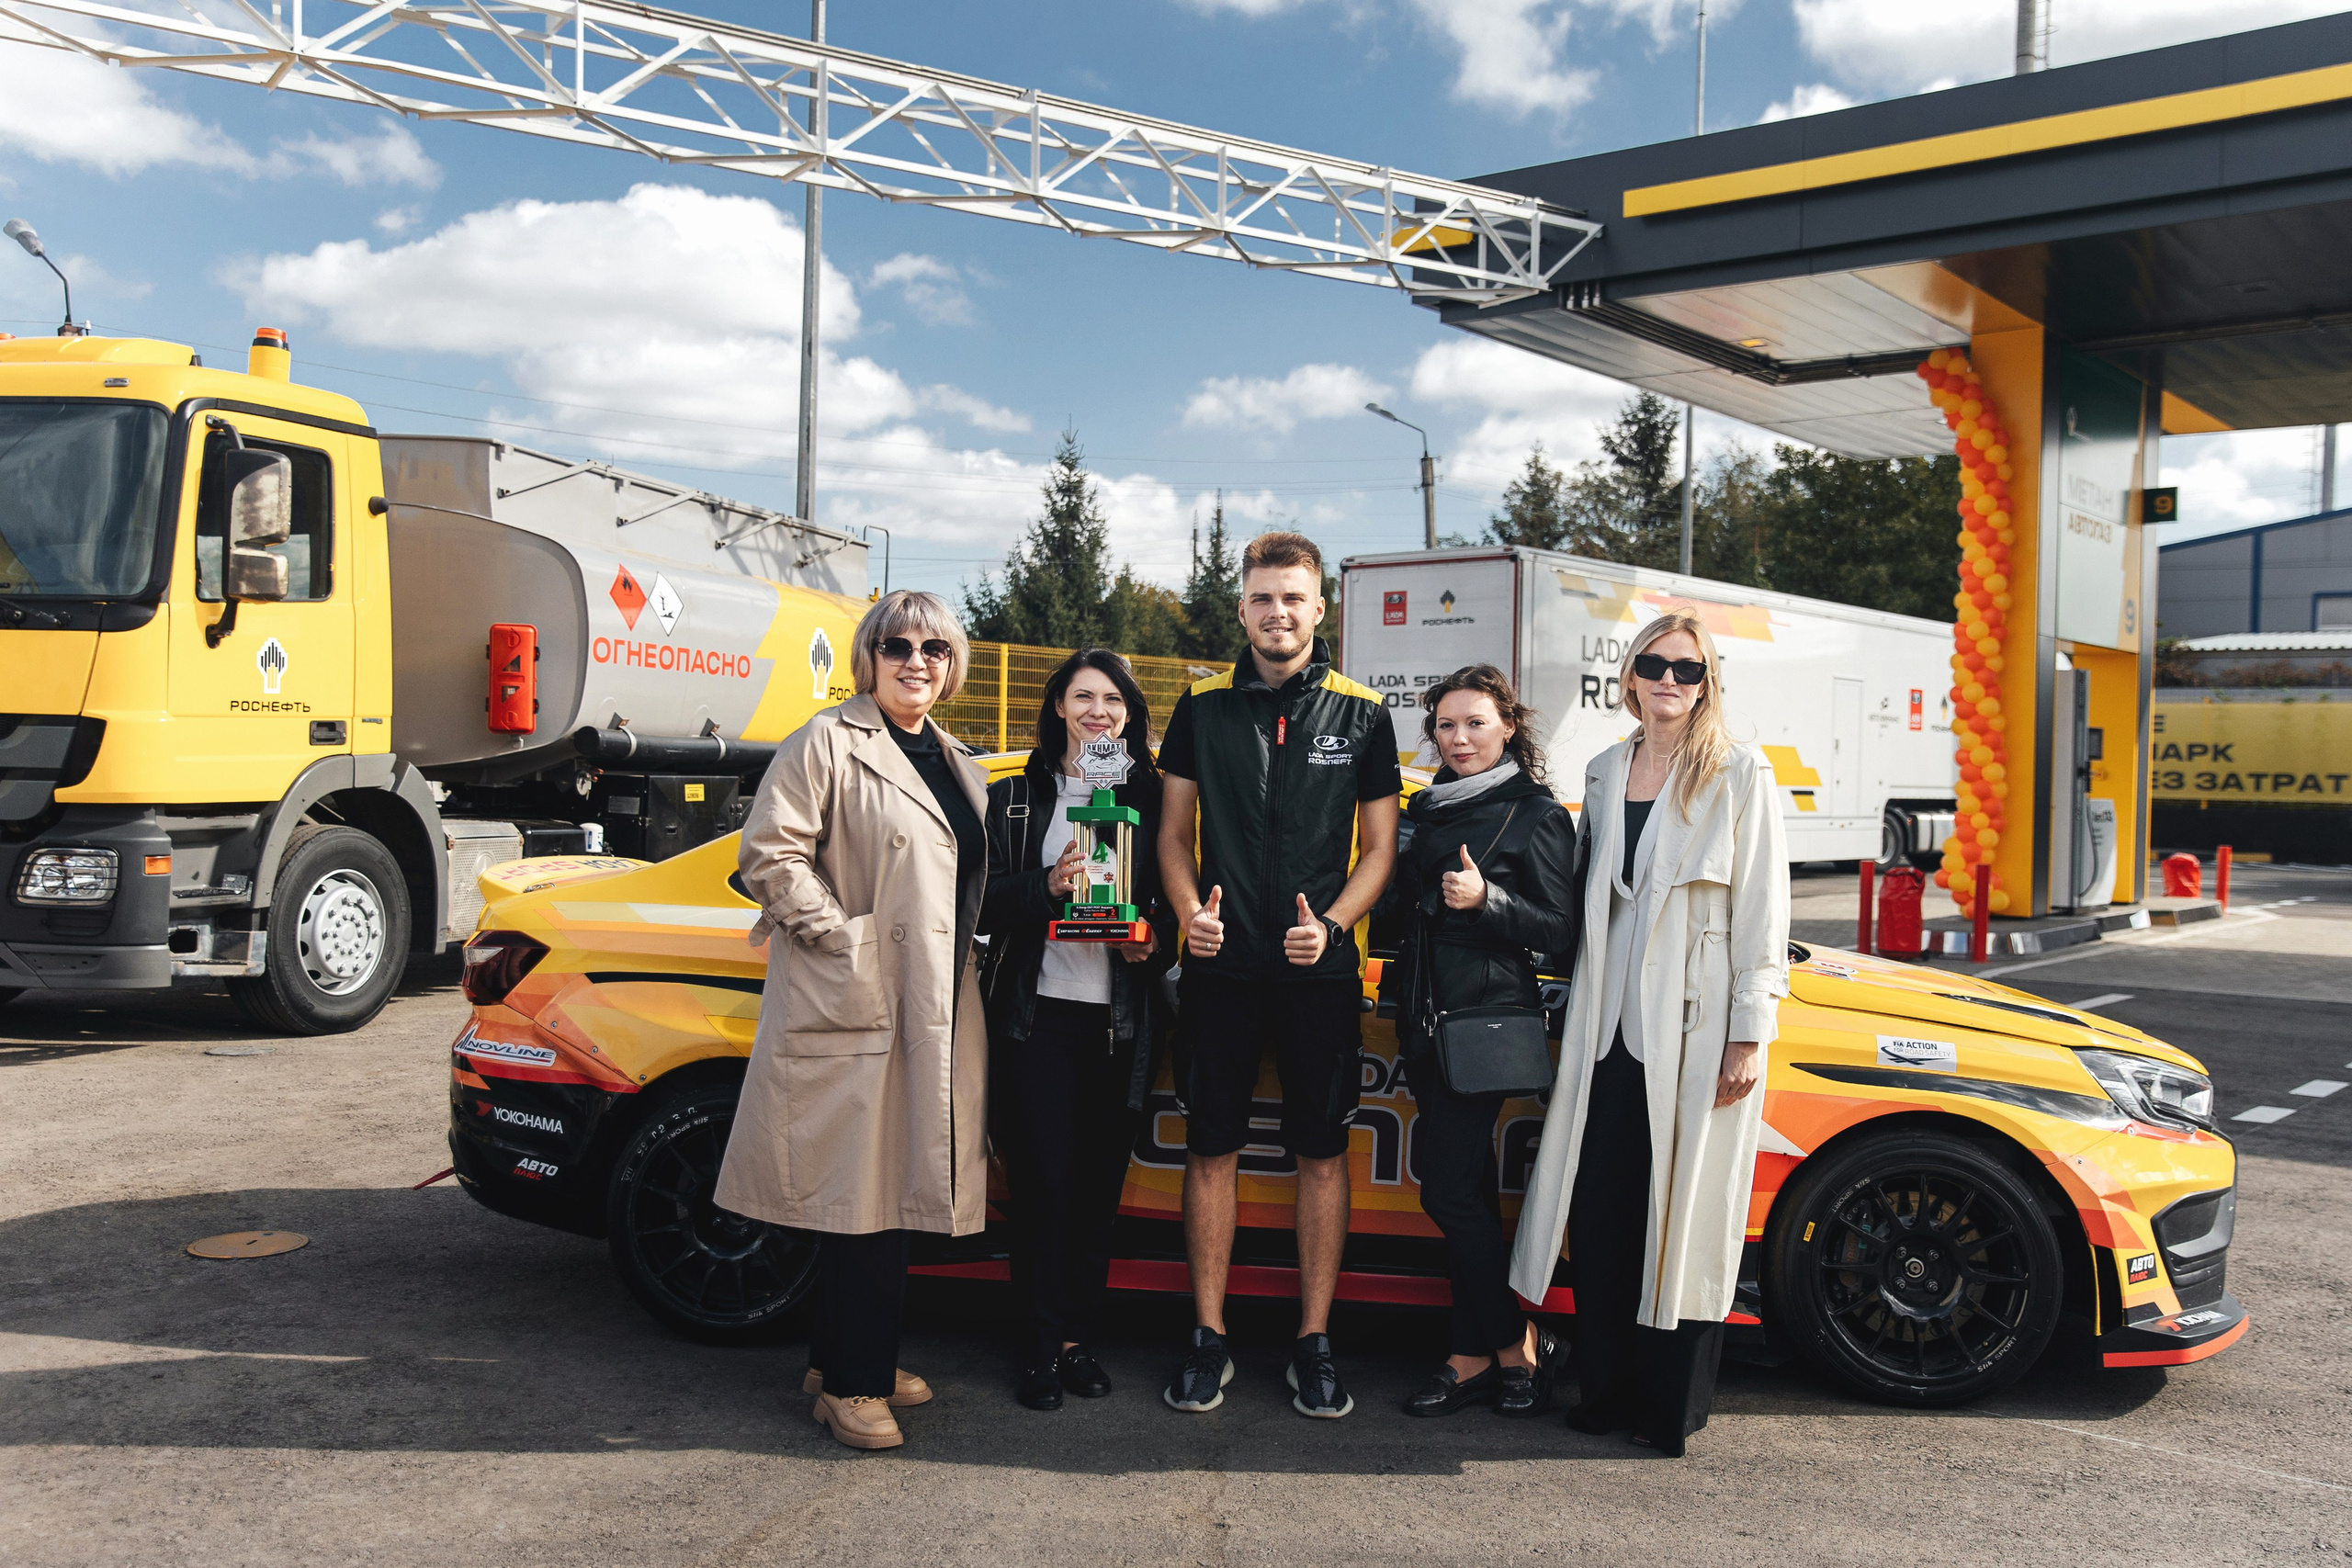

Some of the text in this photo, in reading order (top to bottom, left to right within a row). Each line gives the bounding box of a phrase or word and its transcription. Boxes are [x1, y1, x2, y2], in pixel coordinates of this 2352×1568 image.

[2154, 496, 2174, 514] 9
[1422, 616, 1476, 626] РОСНЕФТЬ
[592, 637, 752, 679] ОГНЕОПАСНО
[1369, 675, 1407, 687] LADA
[230, 700, 311, 713] РОСНЕФТЬ
[1086, 743, 1121, 754] AKHMAT
[2195, 772, 2349, 794] ЗАТРАТ
[1091, 840, 1109, 862] 4
[491, 859, 641, 880] LADA SPORT
[1905, 1042, 1938, 1050] ACTION
[493, 1106, 564, 1134] YOKOHAMA
[513, 1168, 543, 1180] ПЛЮС
[517, 1157, 560, 1177] АВТО
[1831, 1177, 1871, 1213] Slik SPORT
[2130, 1254, 2154, 1274] АВТО
[747, 1294, 791, 1320] Slik SPORT
[2173, 1310, 2227, 1326] YOKOHAMA
[1977, 1335, 2018, 1373] Slik SPORT
